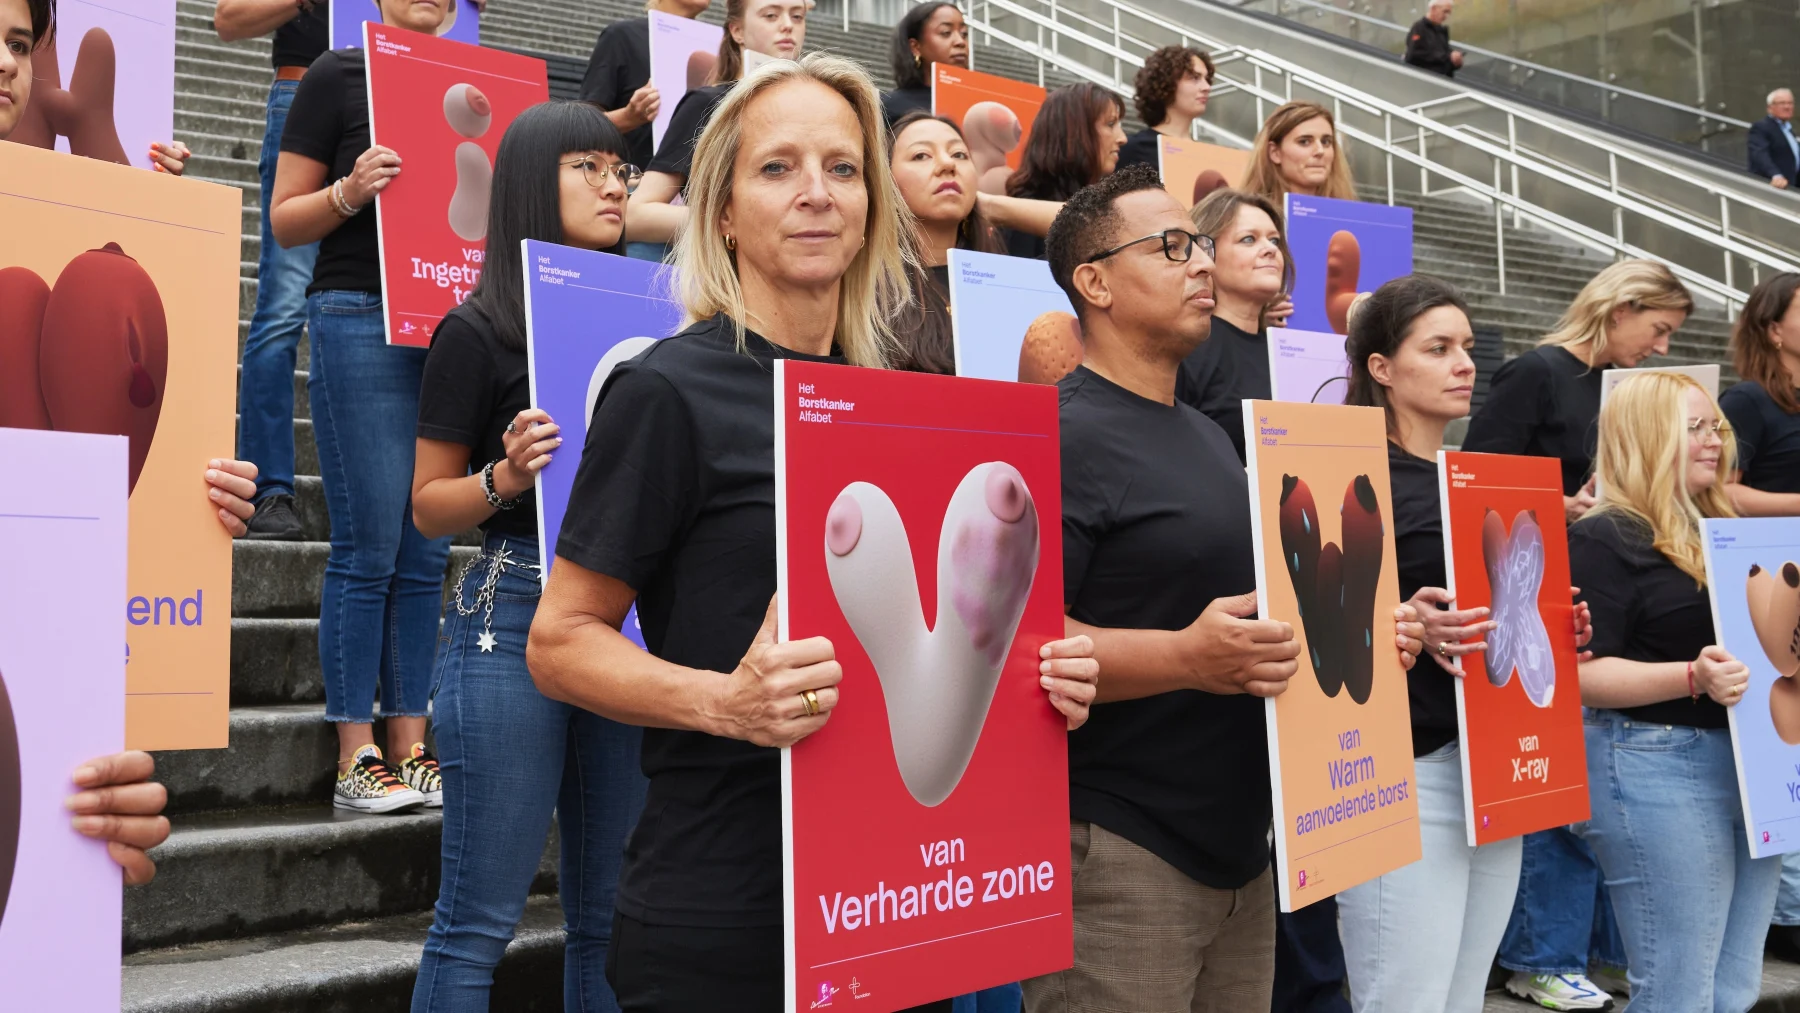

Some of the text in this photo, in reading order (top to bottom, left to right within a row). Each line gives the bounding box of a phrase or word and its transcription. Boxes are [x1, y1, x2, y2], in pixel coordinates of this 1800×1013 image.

[538, 256, 551, 264] Het
[539, 265, 580, 279] Borstkanker
[540, 274, 564, 285] Alfabet
[798, 382, 815, 394] Het
[798, 396, 855, 411] Borstkanker
[799, 410, 832, 423] Alfabet
[1338, 728, 1361, 751] van
[1518, 735, 1539, 752] van
[1328, 755, 1375, 790] Warm
[1511, 757, 1549, 783] X-ray
[1296, 777, 1409, 836] aanvoelende borst
[919, 837, 965, 868] van
[819, 860, 1054, 934] Verharde zone
